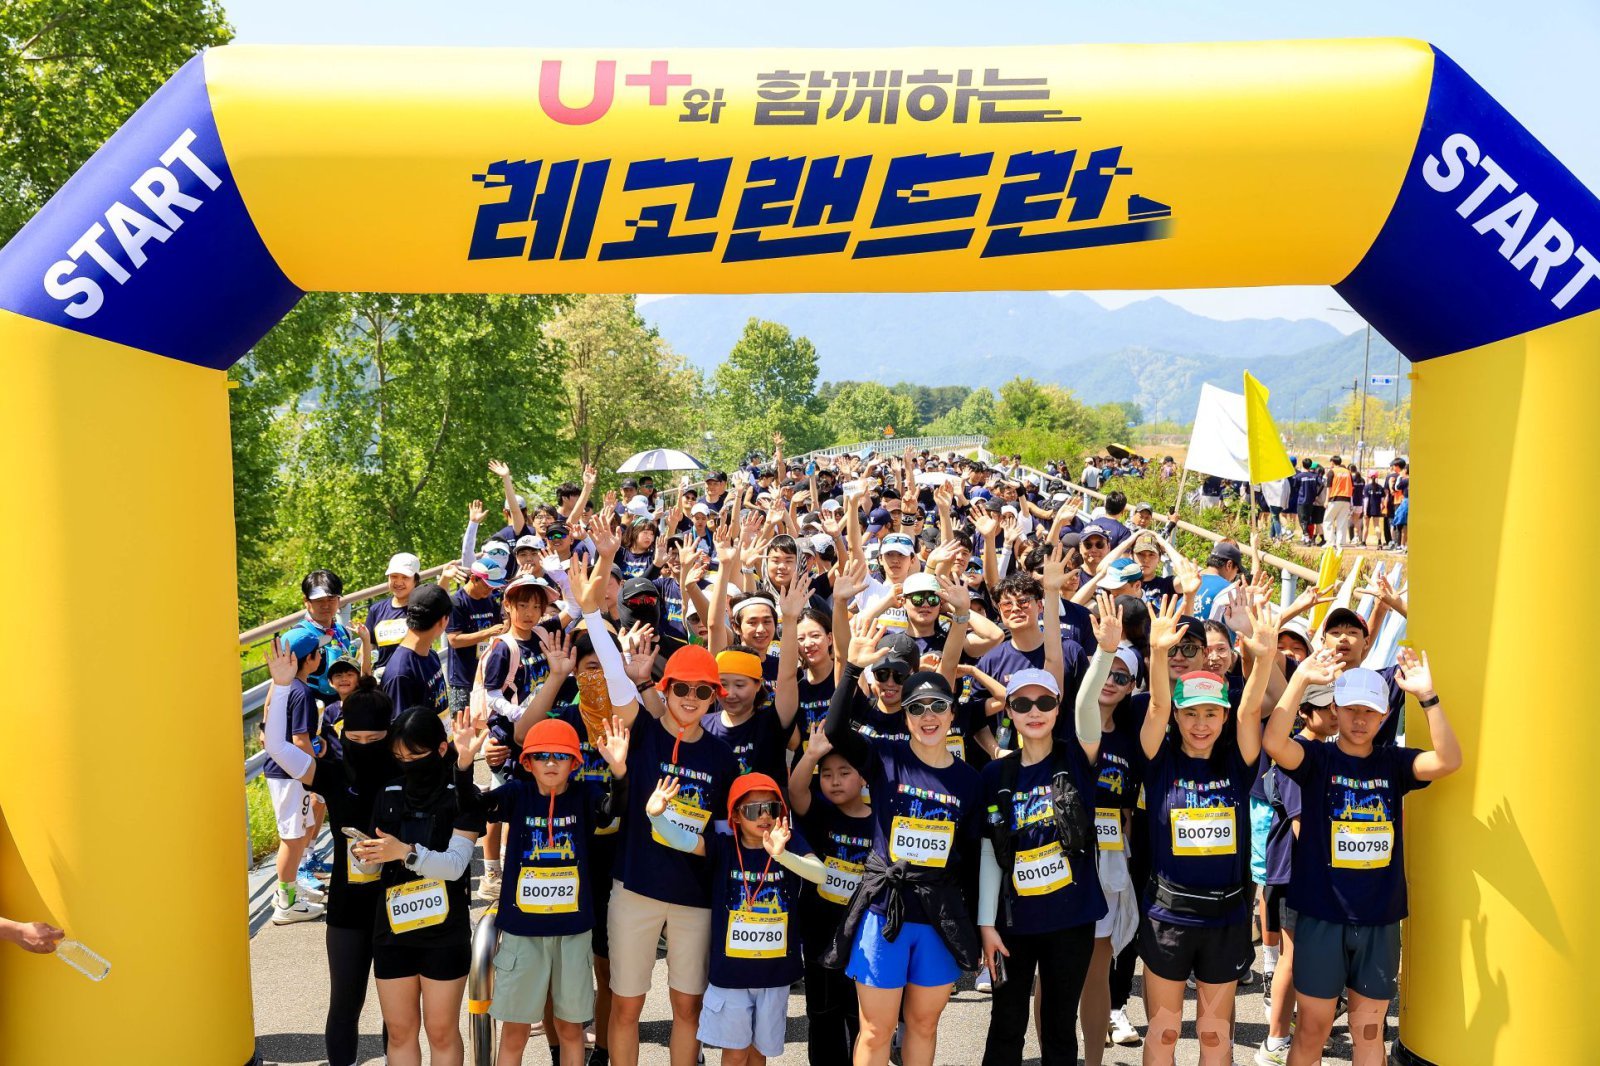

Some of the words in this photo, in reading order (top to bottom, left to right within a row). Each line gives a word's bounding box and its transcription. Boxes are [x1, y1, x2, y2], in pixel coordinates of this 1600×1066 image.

[538, 59, 727, 126] U+와
[752, 69, 1082, 126] 함께하는
[43, 127, 223, 320] START
[1421, 132, 1600, 311] START
[1177, 826, 1231, 839] B00799
[896, 834, 947, 851] B01053
[1338, 840, 1389, 853] B00798
[1016, 859, 1065, 882] B01054
[522, 885, 574, 898] B00782
[392, 895, 443, 917] B00709
[732, 929, 783, 943] B00780
